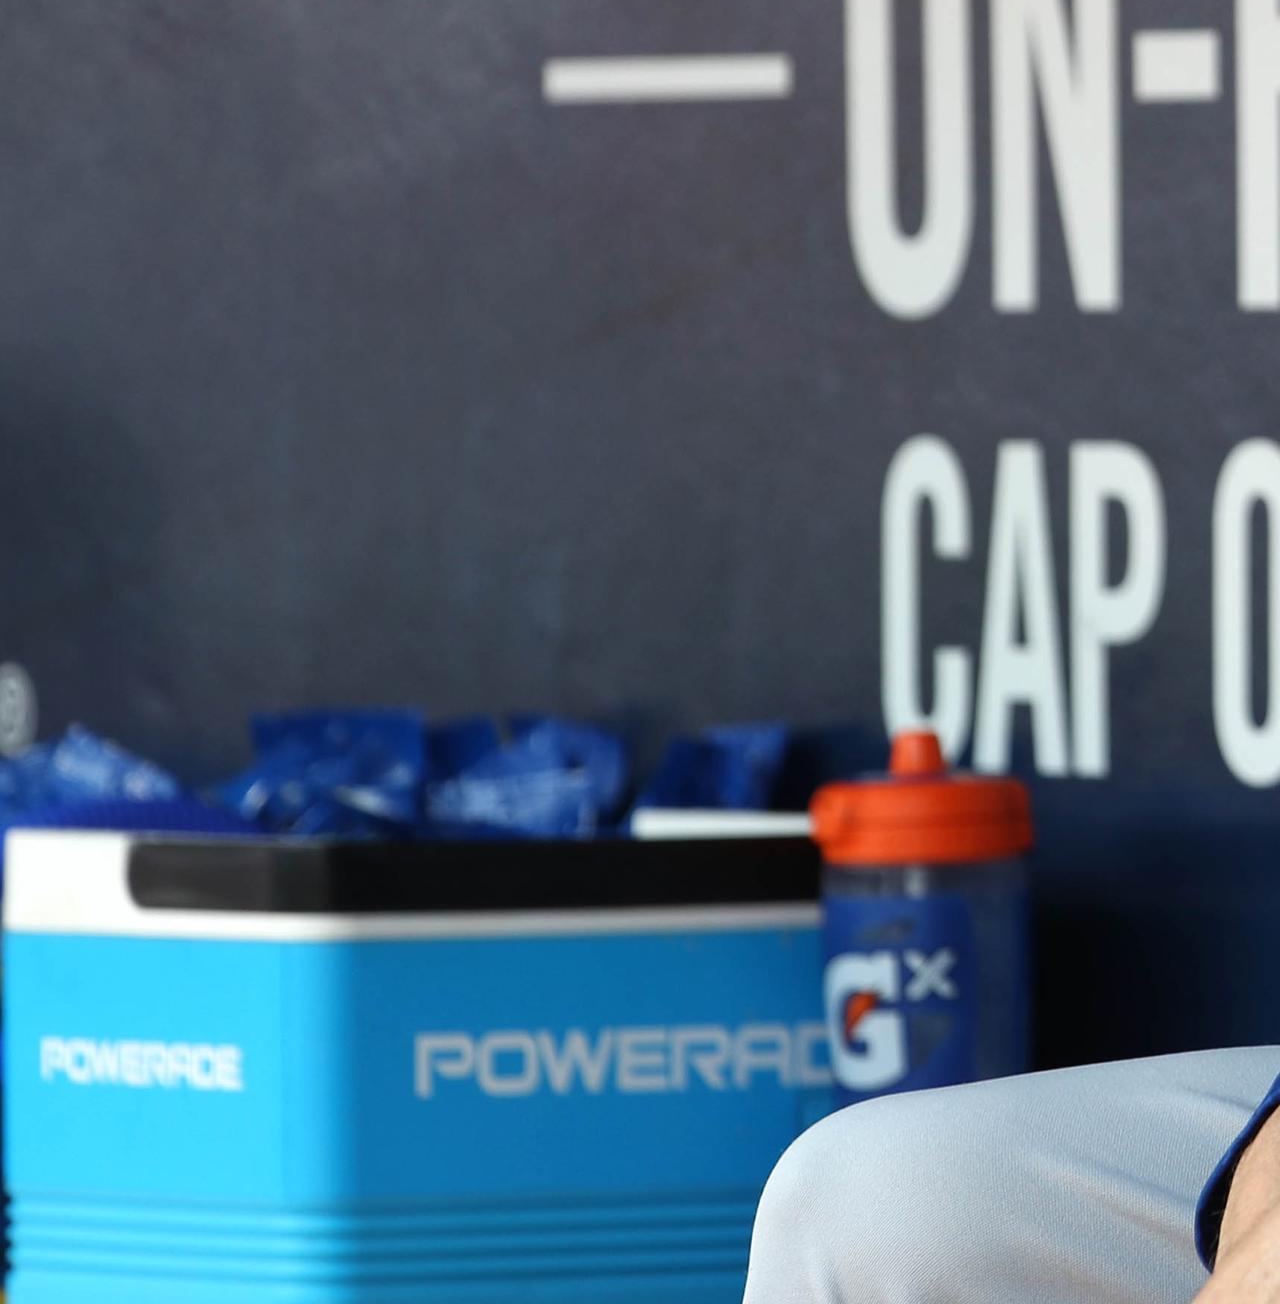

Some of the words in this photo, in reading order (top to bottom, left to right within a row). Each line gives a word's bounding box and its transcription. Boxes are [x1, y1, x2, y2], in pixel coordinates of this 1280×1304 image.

[880, 434, 1167, 779] CAP
[40, 1035, 244, 1092] POWERADE
[413, 1018, 836, 1098] POWERAD
